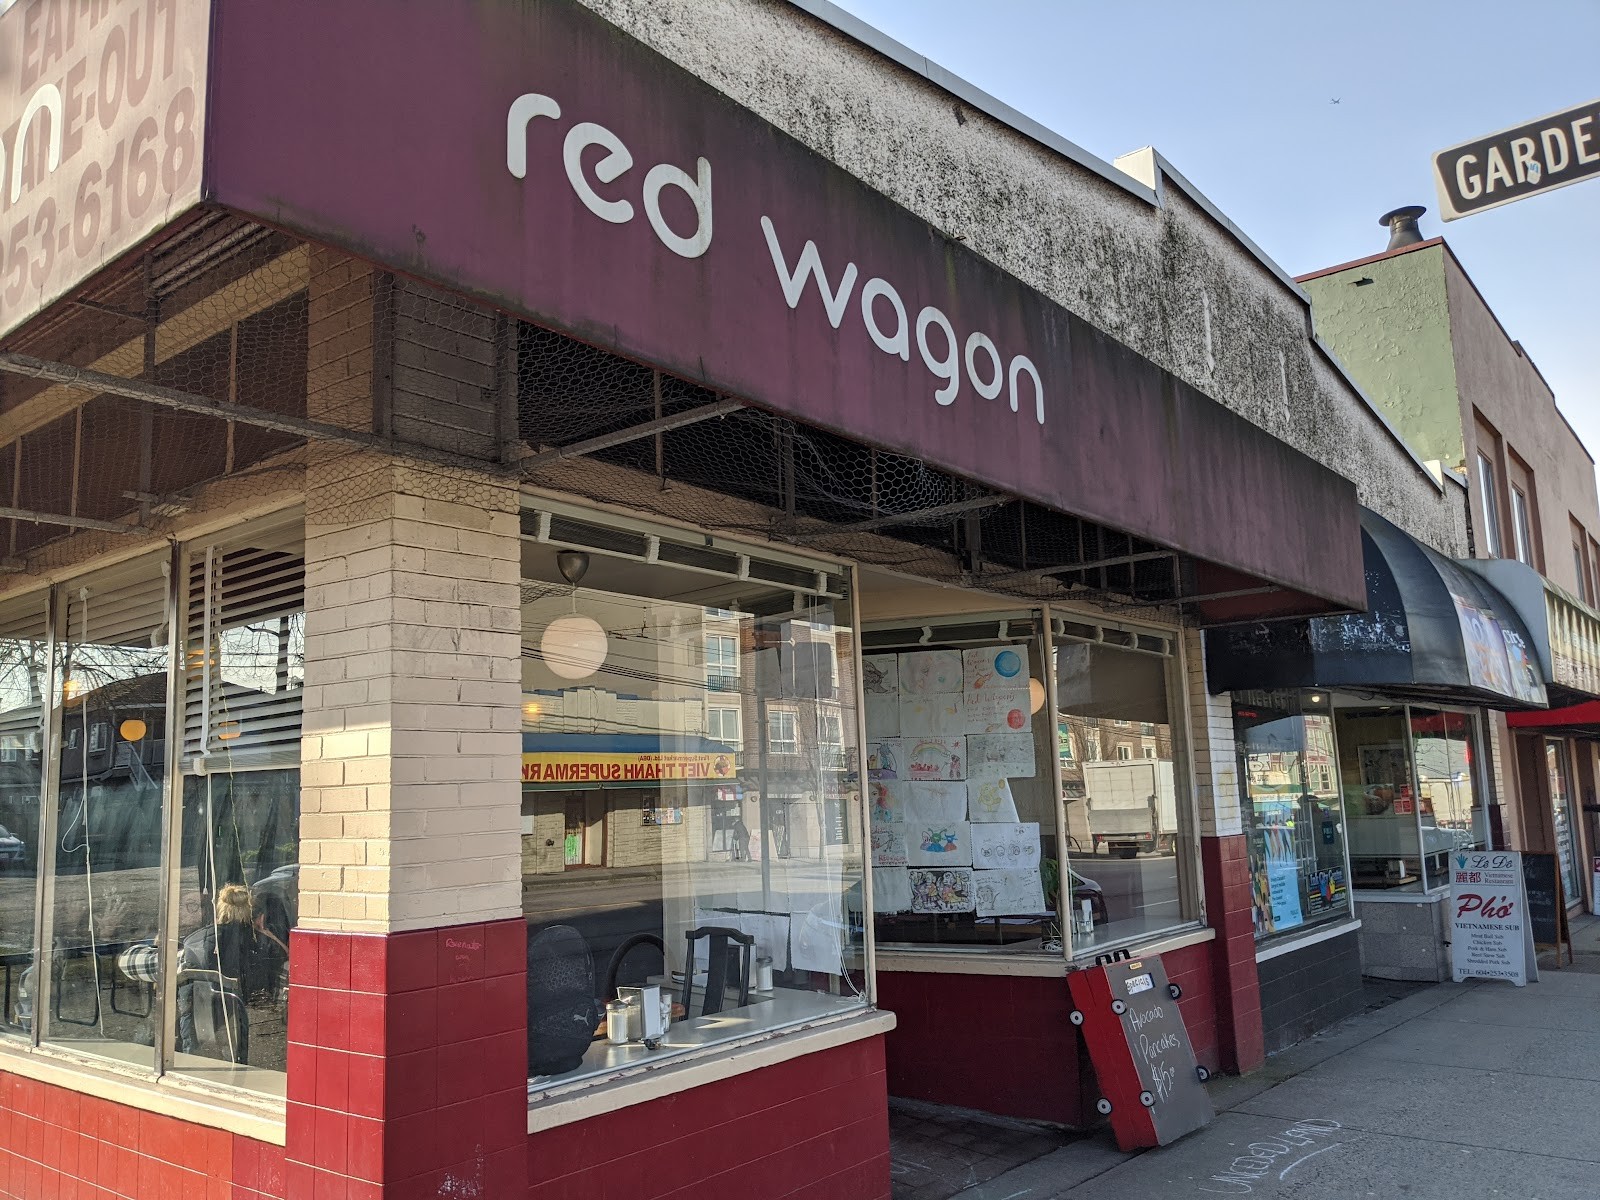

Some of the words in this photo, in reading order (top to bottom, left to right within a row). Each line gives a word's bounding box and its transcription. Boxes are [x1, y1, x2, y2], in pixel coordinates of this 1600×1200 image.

[0, 86, 195, 308] 53-6168
[1456, 113, 1600, 200] GARDE
[507, 93, 712, 258] red
[760, 215, 1045, 425] wagon
[1455, 922, 1504, 930] VIETNAMESE
[1129, 1004, 1164, 1033] Avocado
